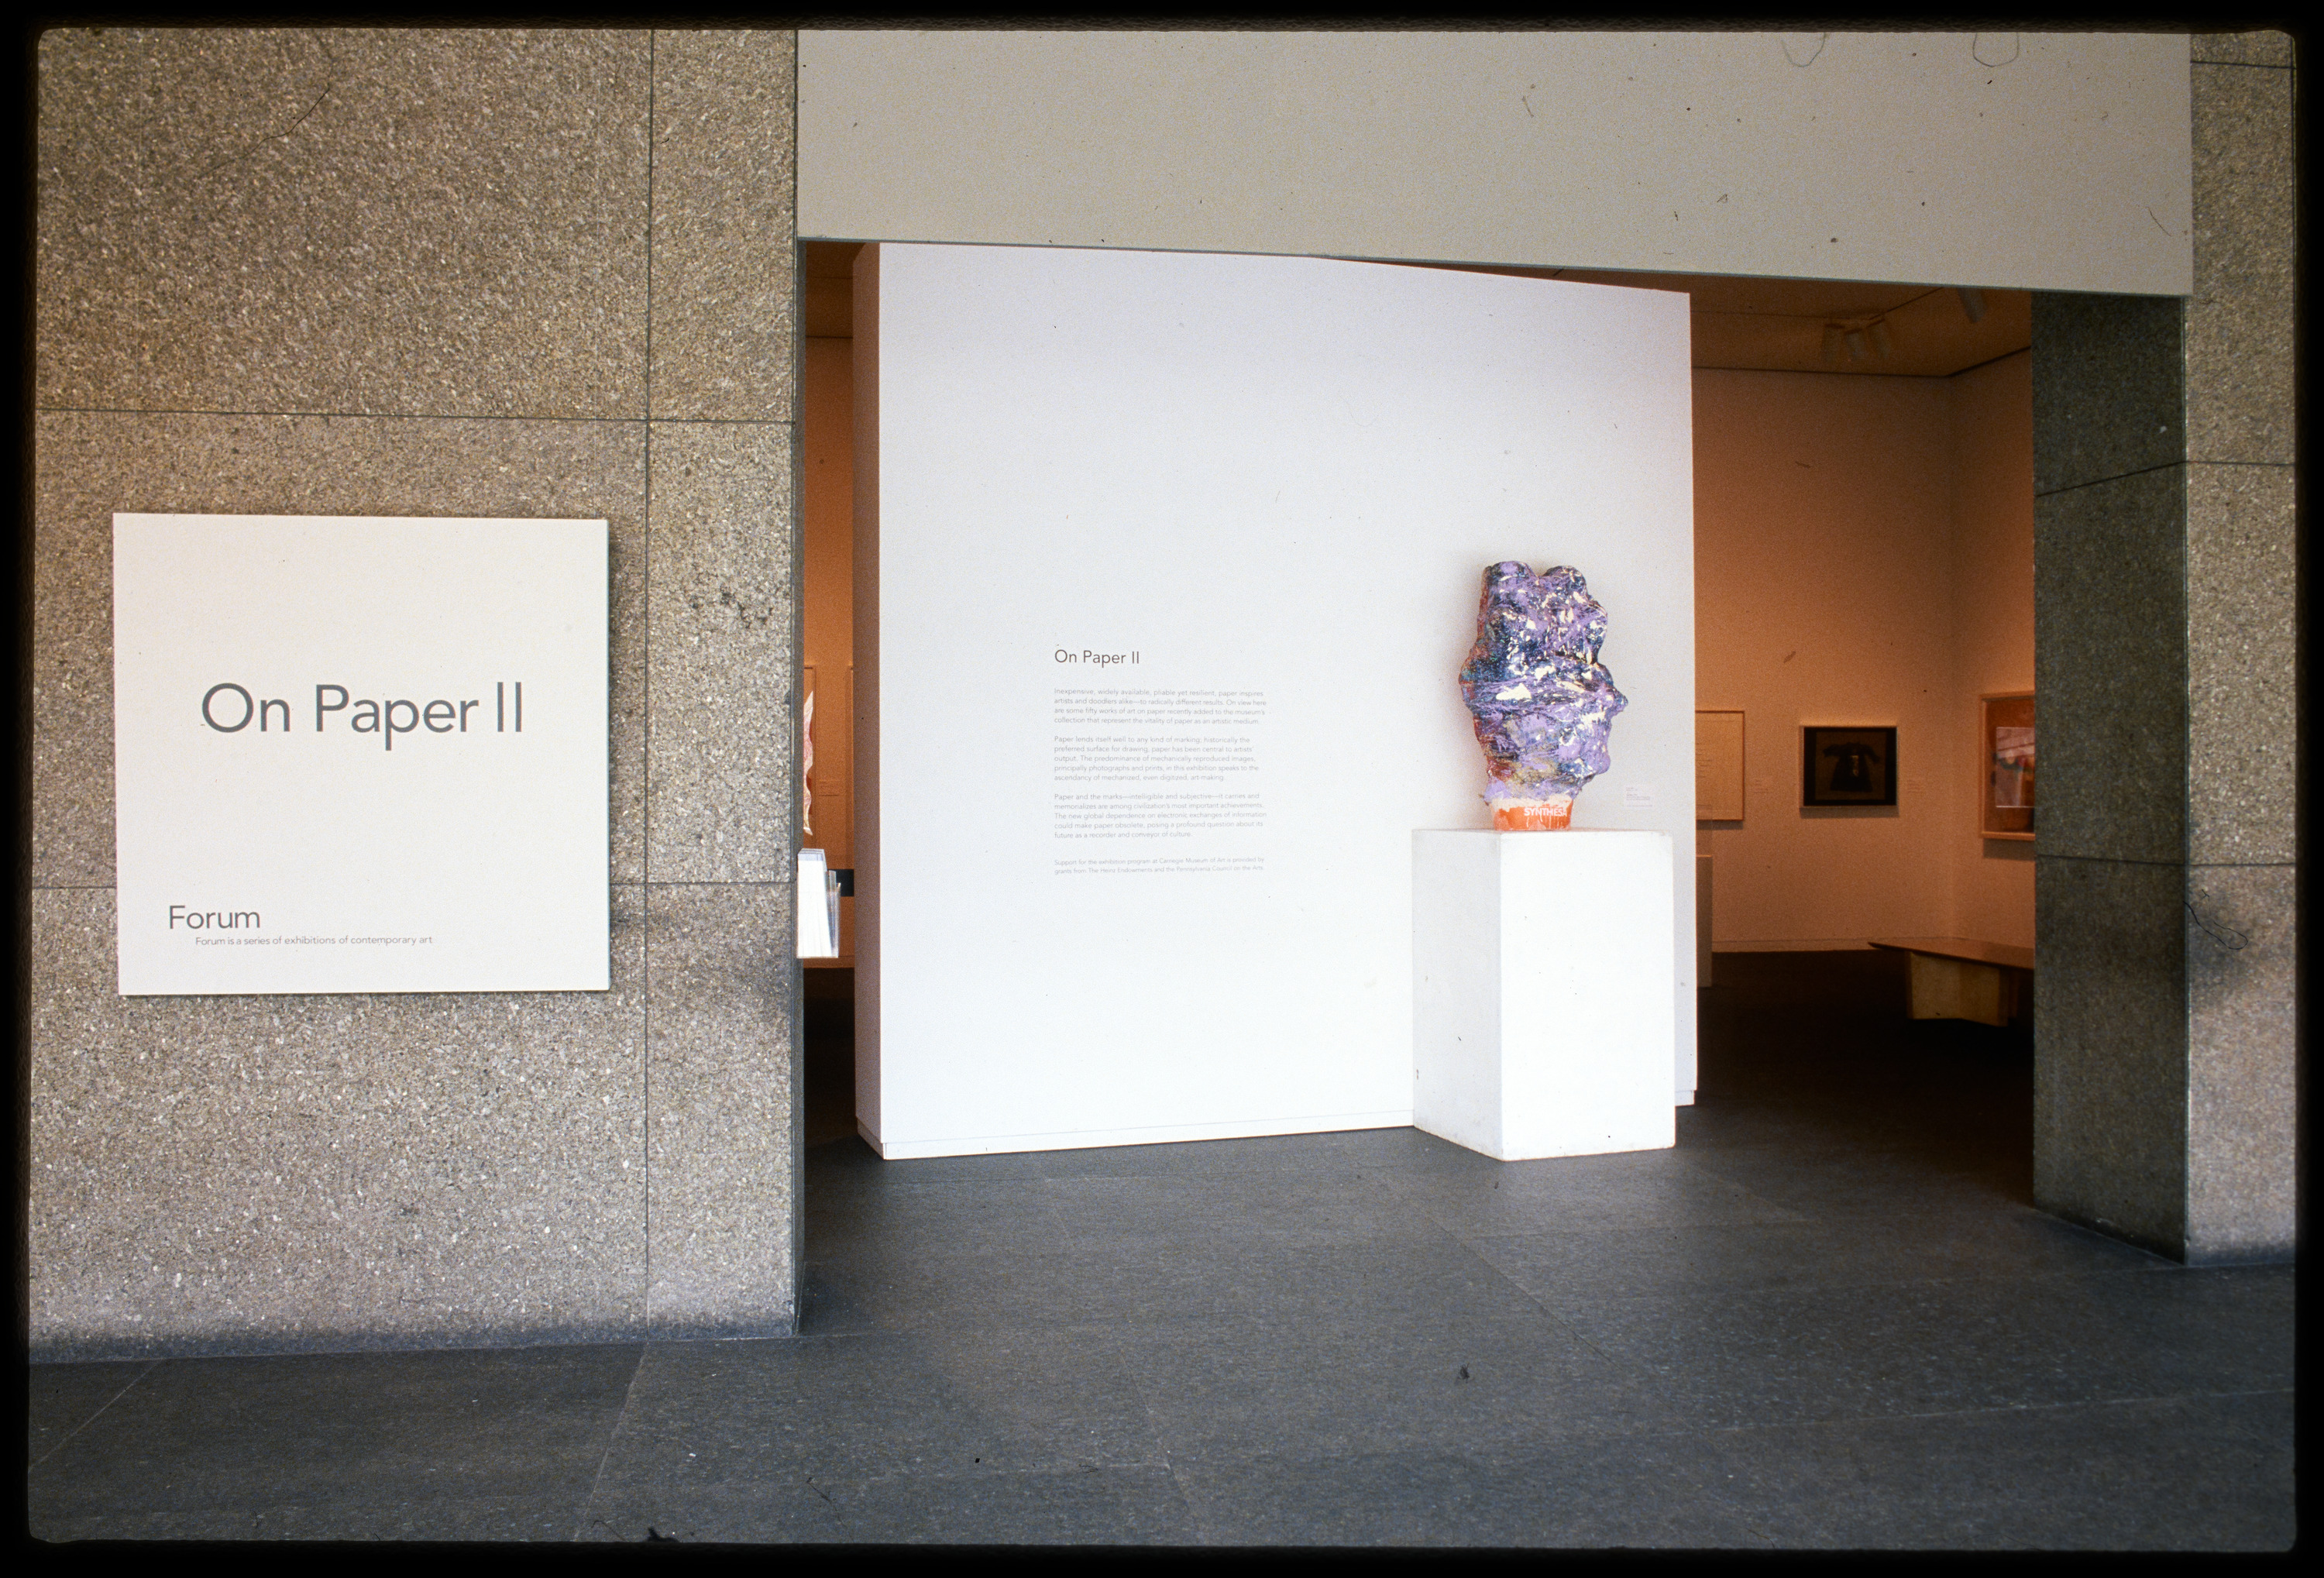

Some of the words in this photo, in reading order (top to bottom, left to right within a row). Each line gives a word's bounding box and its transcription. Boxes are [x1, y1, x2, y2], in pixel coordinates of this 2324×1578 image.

[1055, 649, 1078, 663] On
[1083, 650, 1126, 668] Paper
[1132, 651, 1140, 664] II
[201, 682, 290, 733] On
[315, 684, 479, 751] Paper
[497, 682, 522, 732] II
[169, 905, 260, 930] Forum
[196, 937, 225, 945] Forum
[284, 936, 336, 945] exhibitions
[351, 937, 417, 947] contemporary
[419, 936, 432, 944] art
